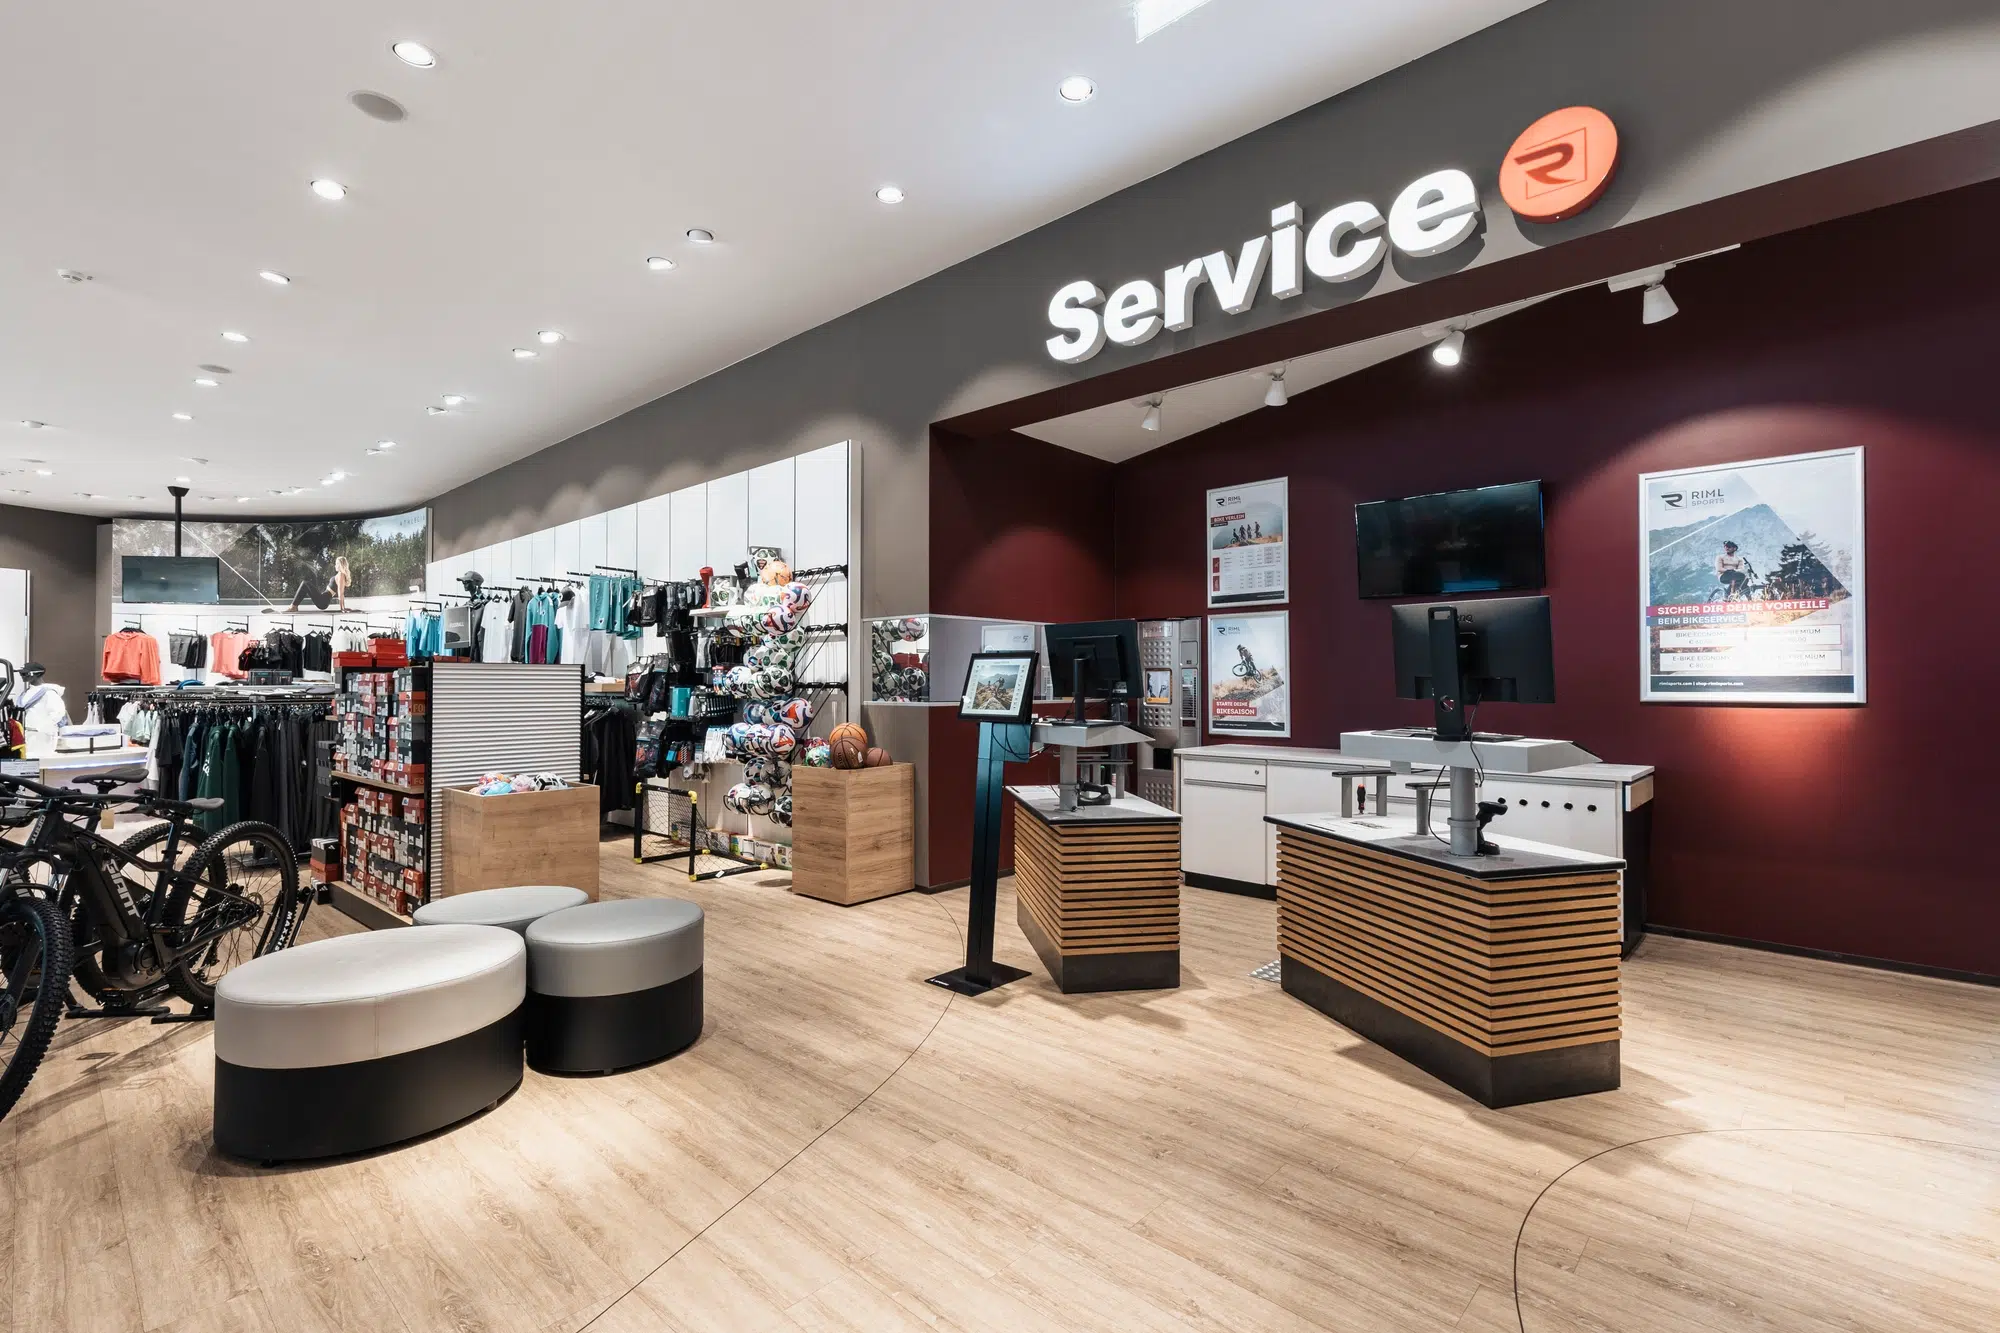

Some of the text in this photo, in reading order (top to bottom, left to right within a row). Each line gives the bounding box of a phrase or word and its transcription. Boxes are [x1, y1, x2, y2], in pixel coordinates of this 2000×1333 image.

[1046, 168, 1480, 364] Service
[1691, 488, 1725, 500] RIML
[1691, 497, 1725, 507] SPORTS
[1658, 600, 1826, 615] SICHER DIR DEINE VORTEILE
[1658, 615, 1745, 625] BEIM BIKESERVICE
[31, 815, 47, 844] GIANT
[105, 857, 142, 918] GIANT
[274, 910, 293, 952] MAXXIS
